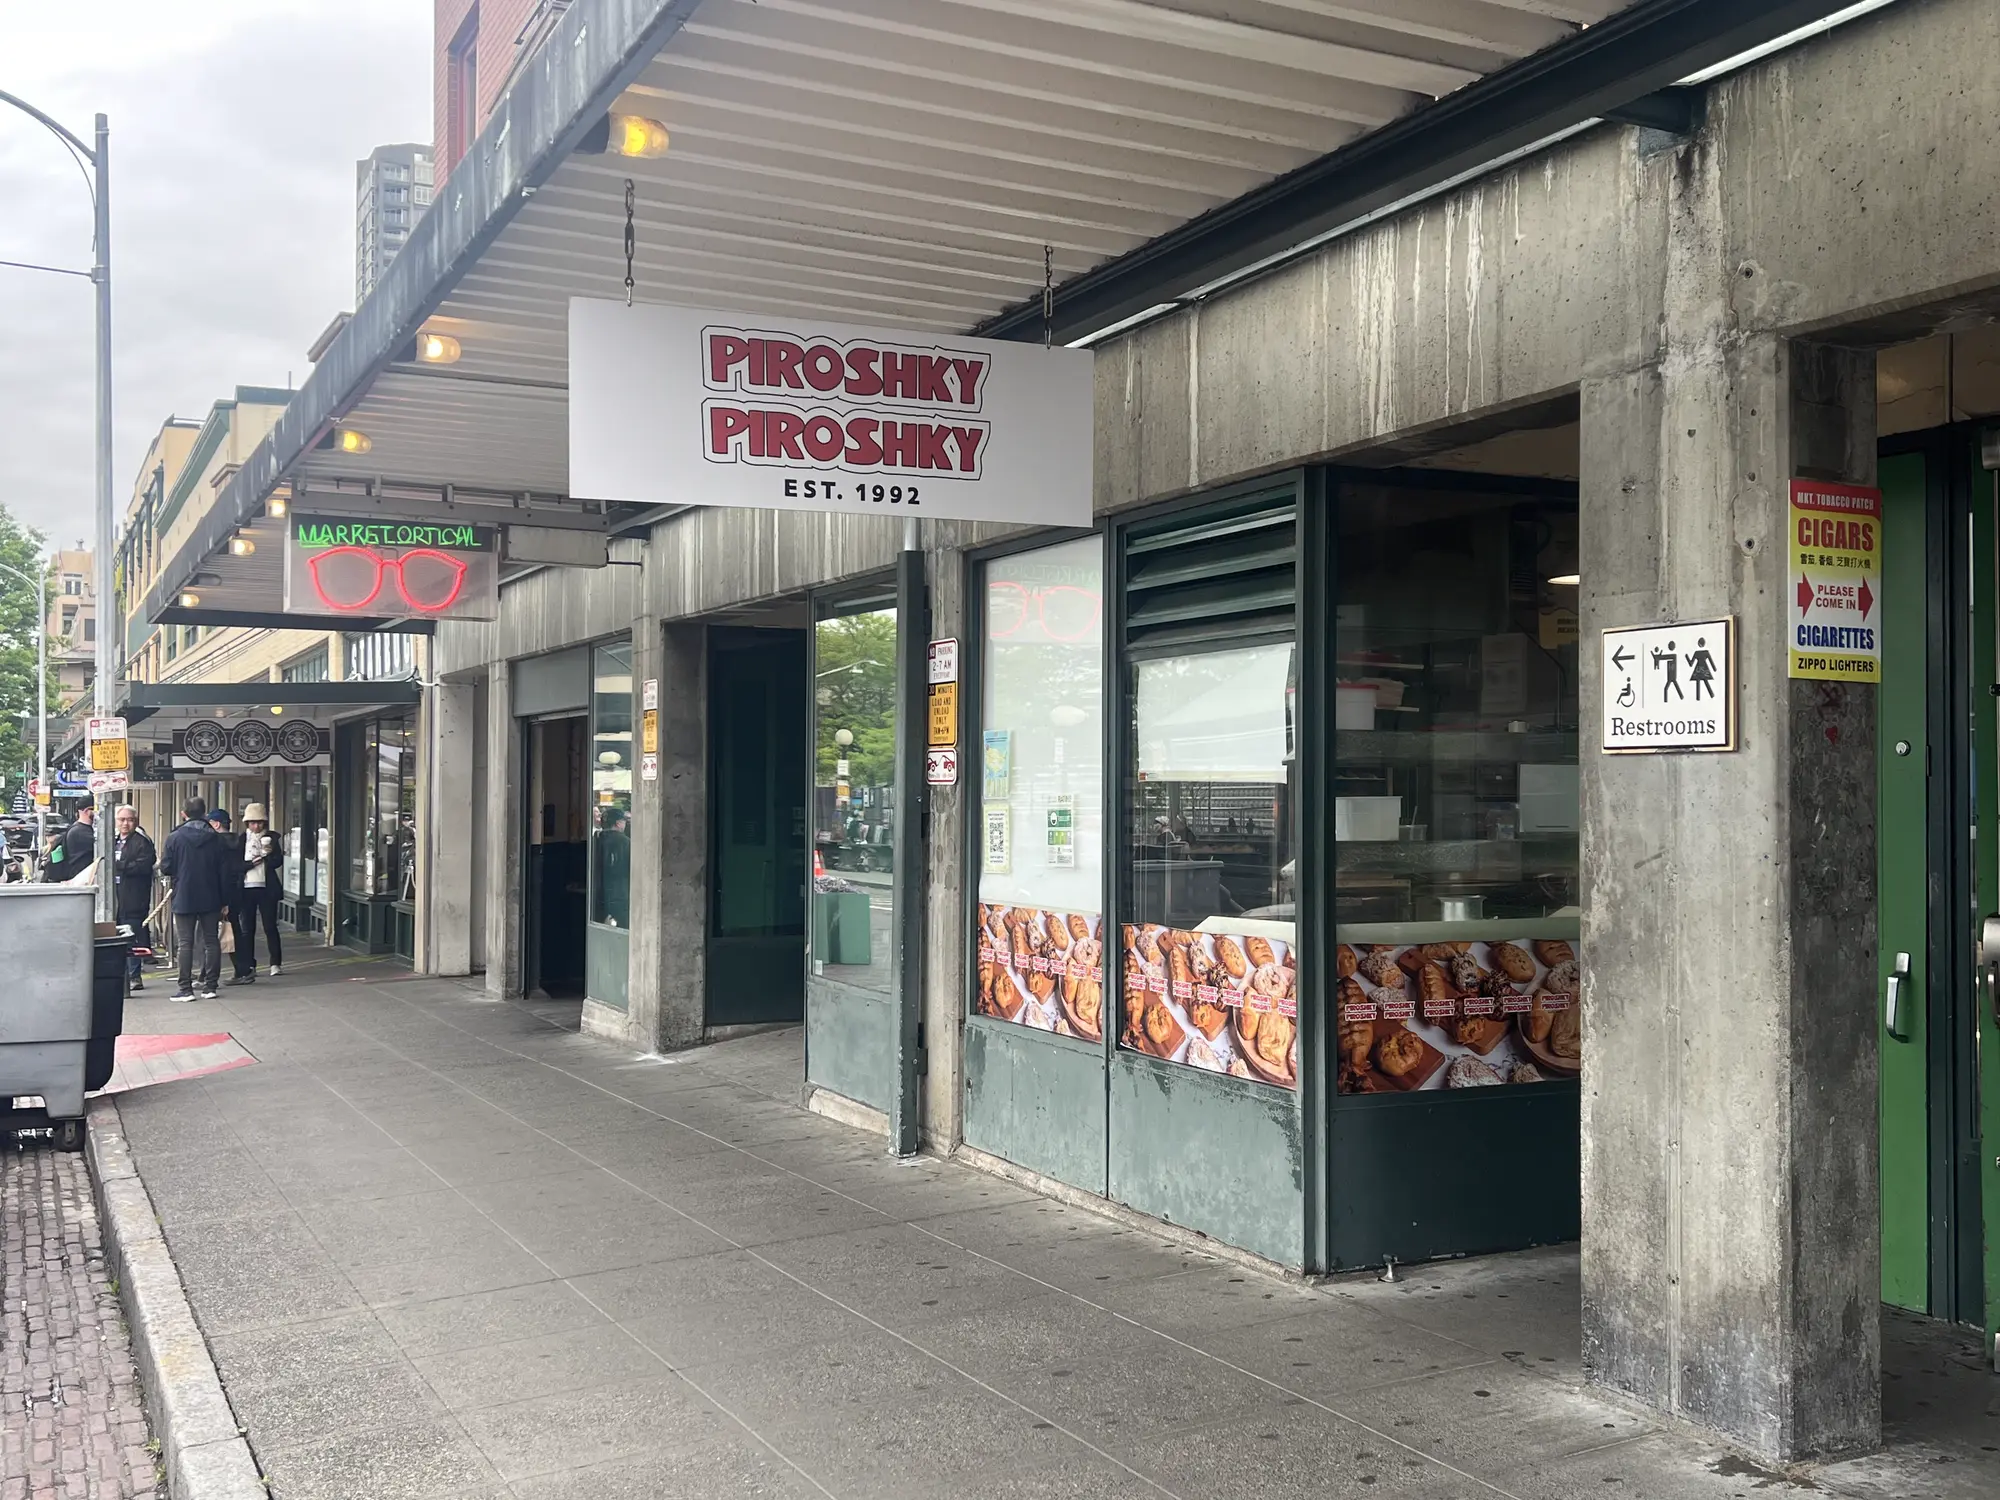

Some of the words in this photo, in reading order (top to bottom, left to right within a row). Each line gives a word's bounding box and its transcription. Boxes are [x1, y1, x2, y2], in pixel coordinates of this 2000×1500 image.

[708, 334, 984, 405] PIROSHKY
[708, 406, 984, 472] PIROSHKY
[783, 478, 843, 501] EST.
[855, 483, 921, 506] 1992
[1797, 491, 1815, 505] MKT.
[1817, 494, 1850, 509] TOBACCO
[1852, 497, 1874, 511] PATCH
[1798, 516, 1874, 552] CIGARS
[1817, 584, 1854, 597] PLEASE
[1815, 597, 1843, 609] COME
[1846, 600, 1857, 610] IN
[1797, 624, 1874, 650] CIGARETTES
[932, 661, 943, 671] 2-7
[944, 660, 952, 670] AM
[1798, 658, 1826, 670] ZIPPO
[1829, 659, 1874, 673] LIGHTERS
[937, 684, 953, 694] MINUTE
[1611, 717, 1716, 736] Restrooms
